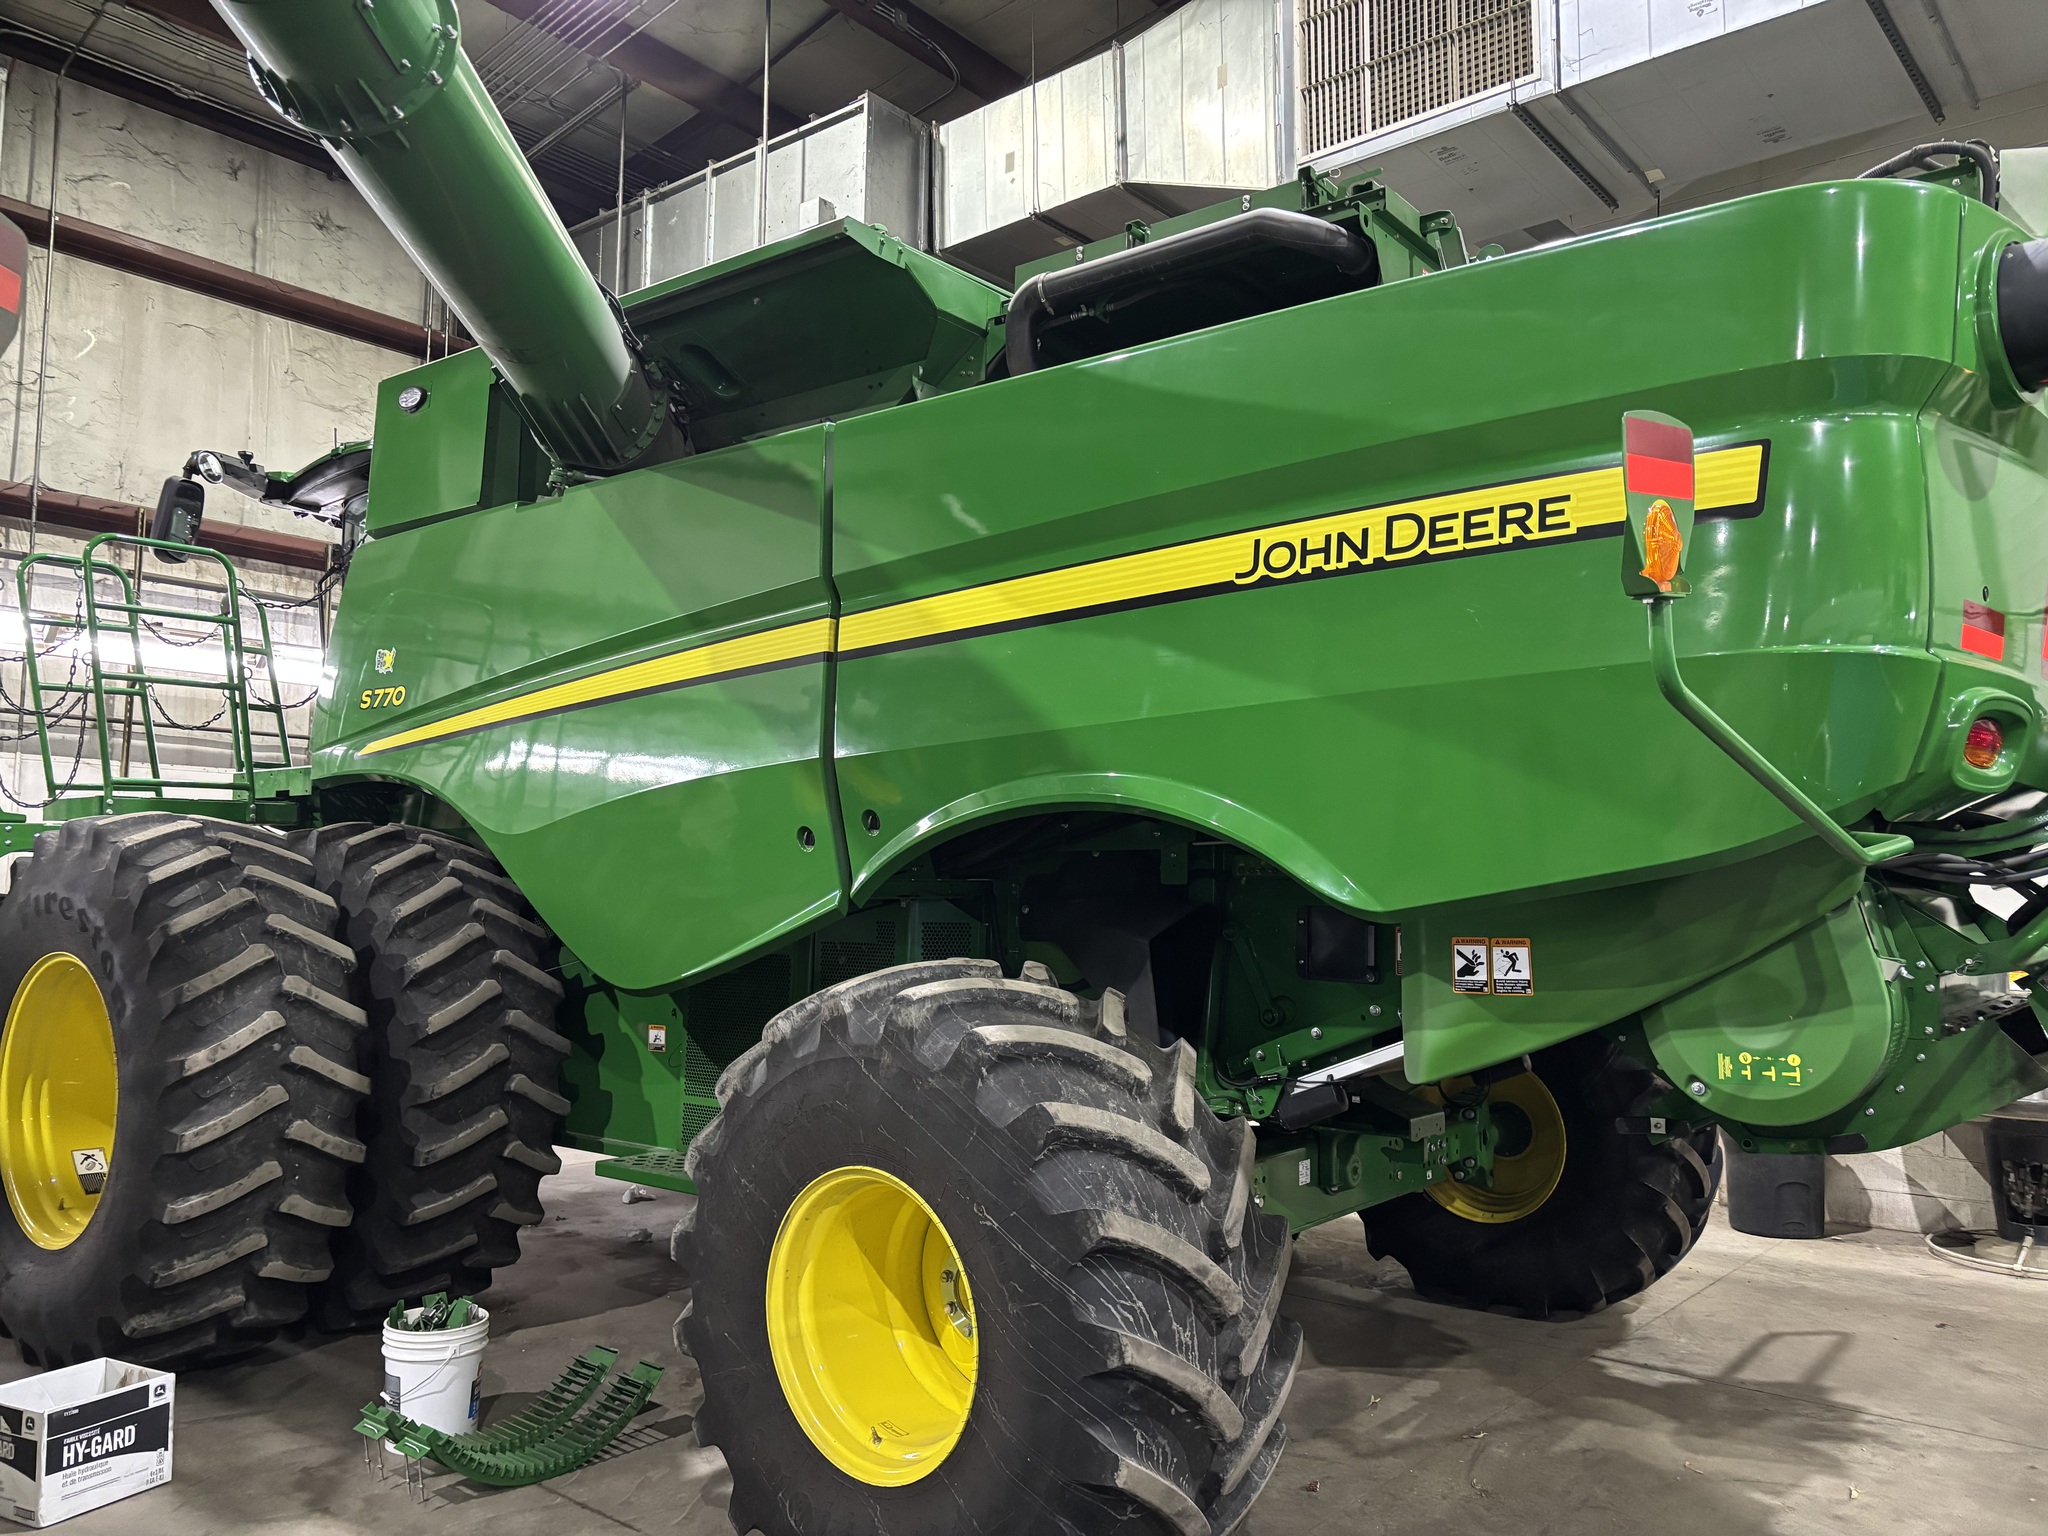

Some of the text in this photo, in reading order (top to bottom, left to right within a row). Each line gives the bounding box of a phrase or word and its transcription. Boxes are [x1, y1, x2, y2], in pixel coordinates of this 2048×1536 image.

[1235, 494, 1571, 580] JOHN DEERE
[360, 685, 406, 709] S770
[62, 1424, 136, 1468] HY-GARD
